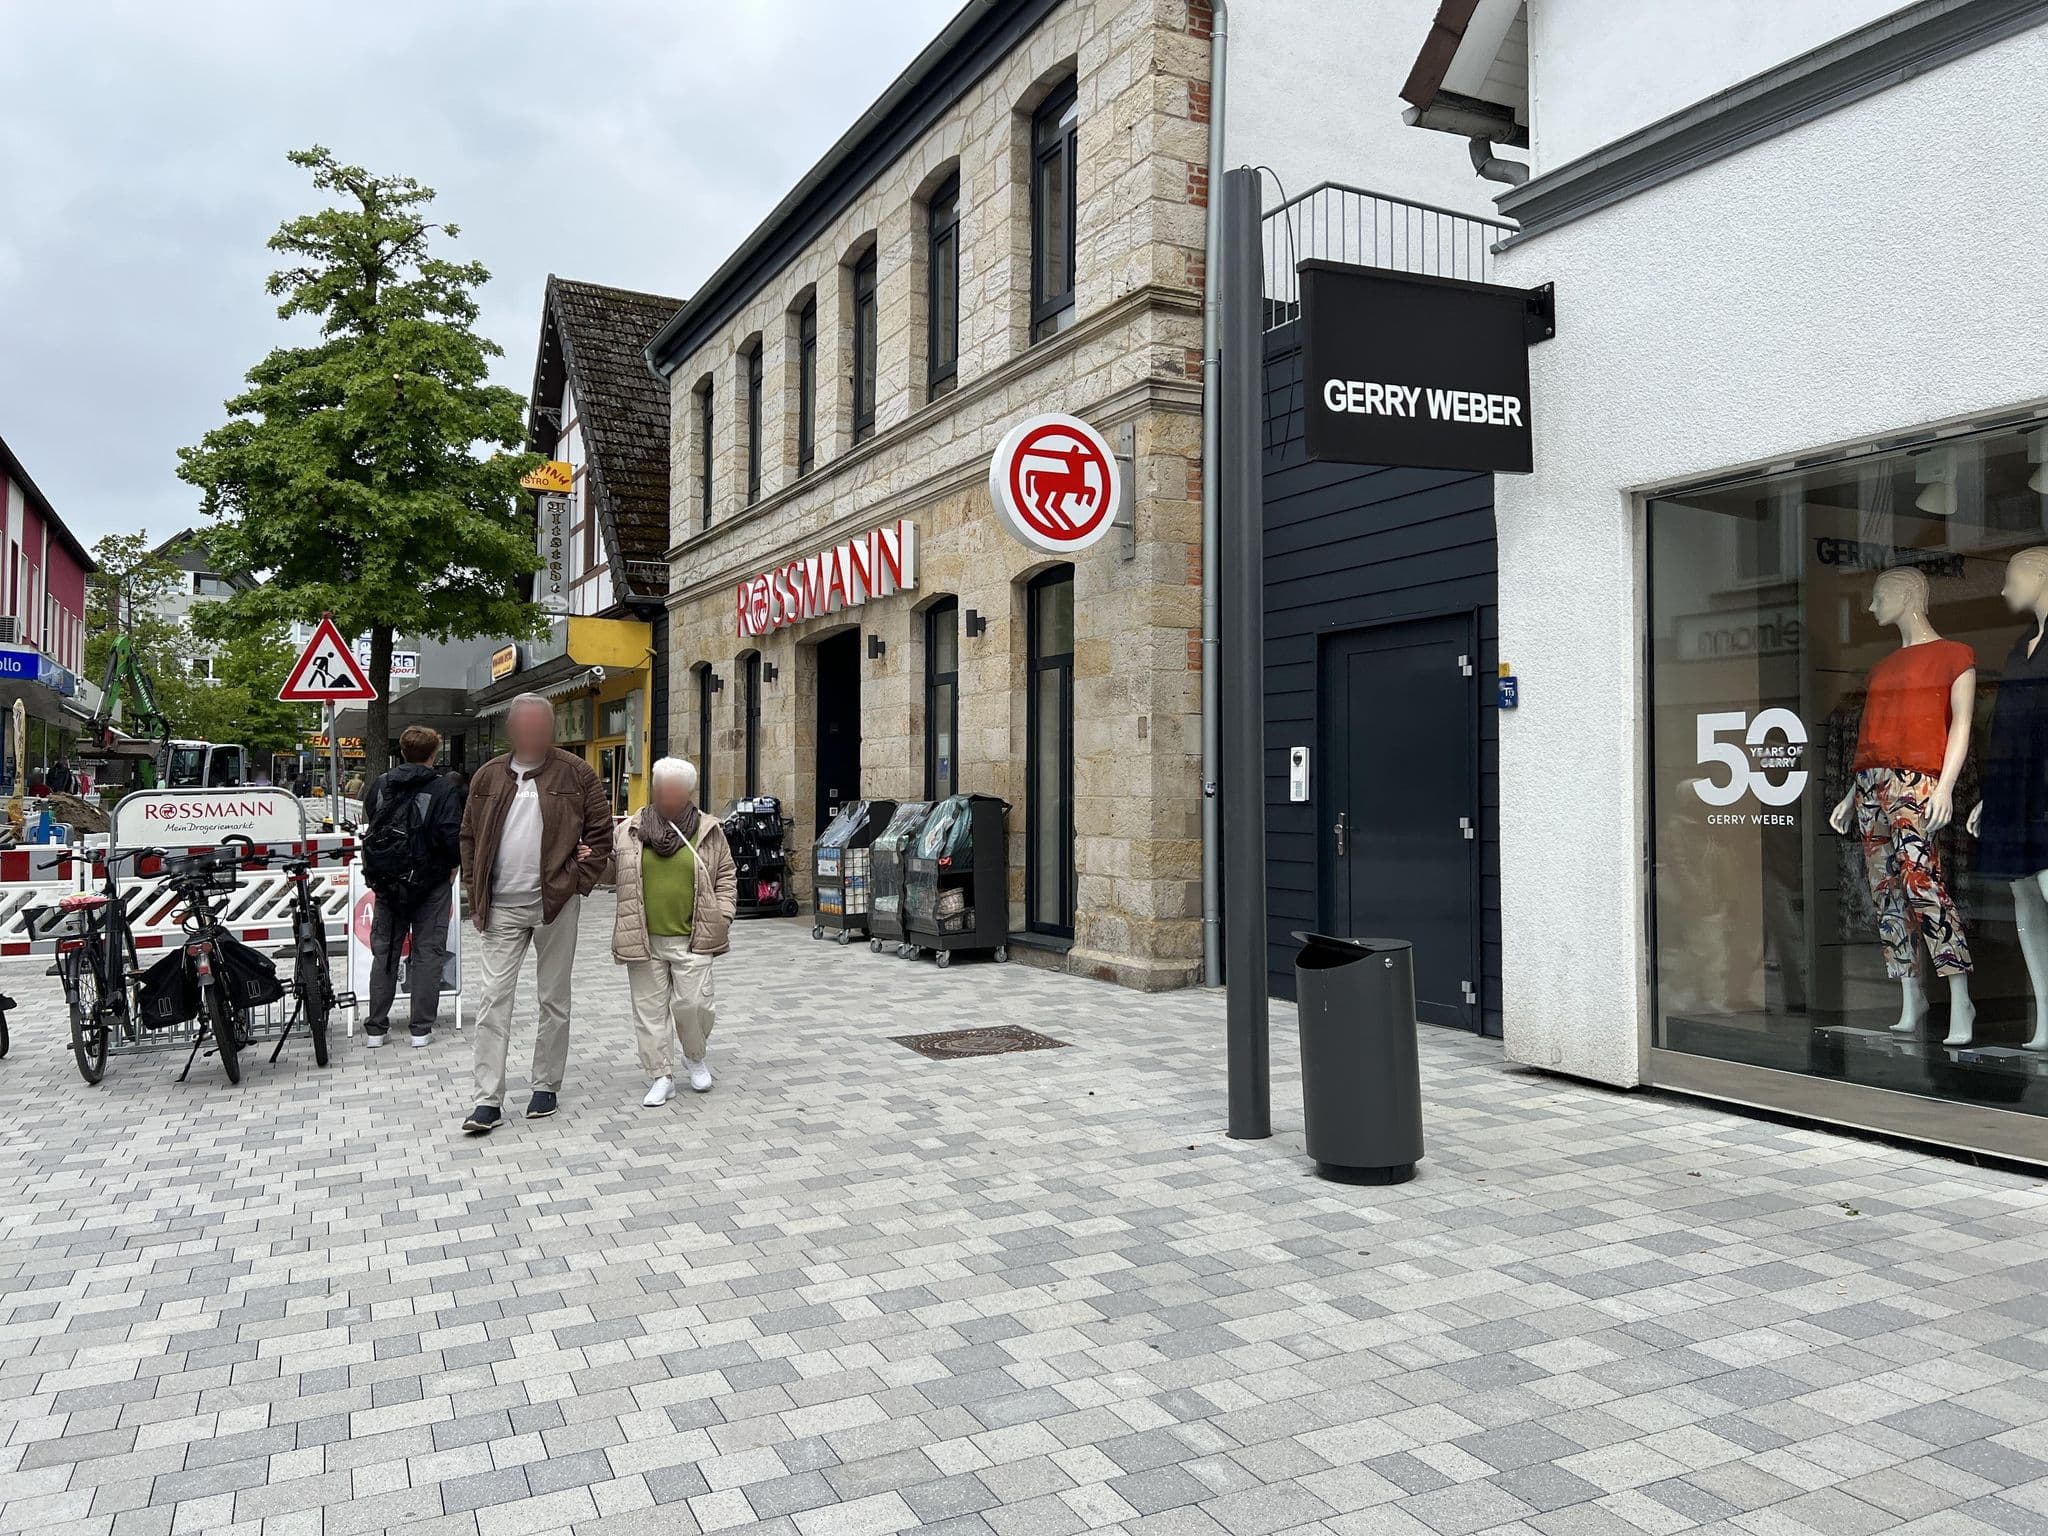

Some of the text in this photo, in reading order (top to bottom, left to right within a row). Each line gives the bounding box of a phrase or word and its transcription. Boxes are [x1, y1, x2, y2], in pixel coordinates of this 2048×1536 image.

[1324, 379, 1523, 427] GERRY WEBER
[522, 476, 549, 486] ISTRO
[736, 520, 905, 638] ROSSMANN
[0, 656, 22, 672] llo
[1693, 708, 1808, 806] 50
[1750, 746, 1803, 757] YEARS OF
[1760, 758, 1796, 768] GERRY
[145, 801, 273, 820] ROSSMANN
[1707, 815, 1794, 825] GERRY WEBER
[165, 821, 255, 835] Mein Drogeriemarkt
